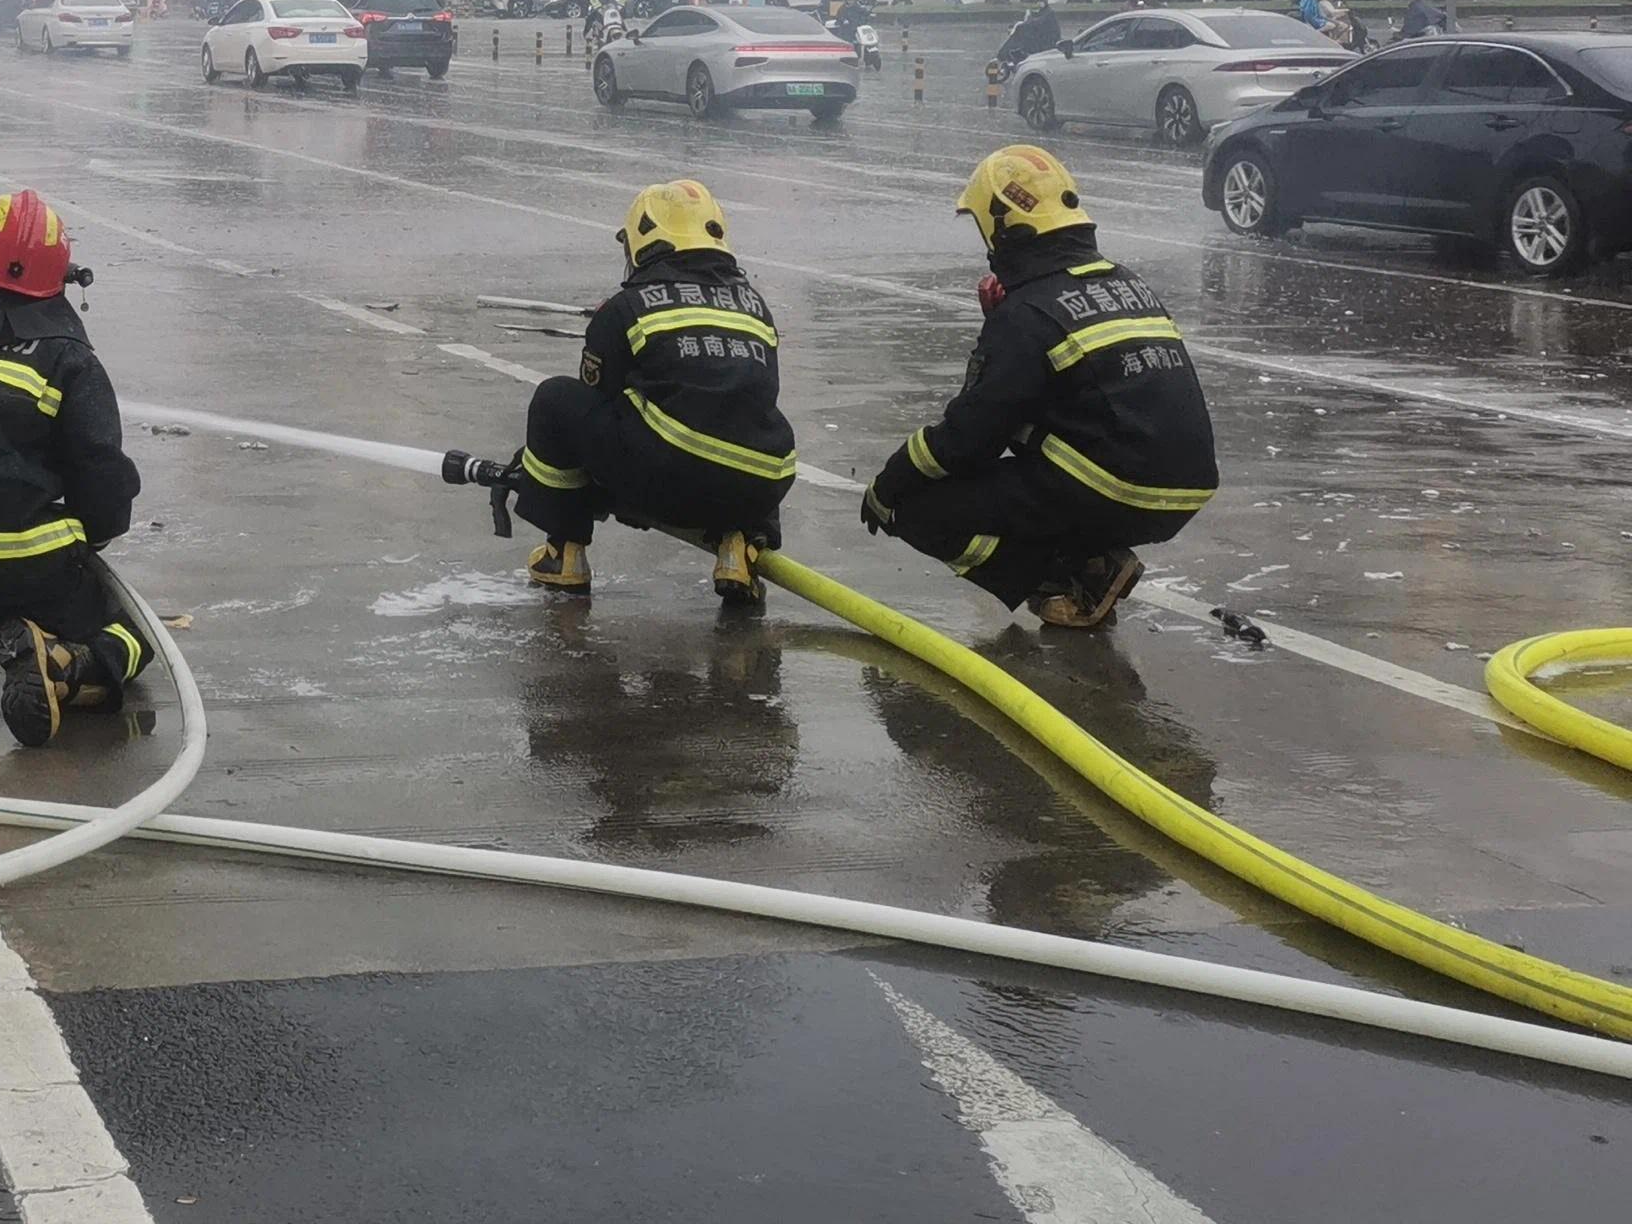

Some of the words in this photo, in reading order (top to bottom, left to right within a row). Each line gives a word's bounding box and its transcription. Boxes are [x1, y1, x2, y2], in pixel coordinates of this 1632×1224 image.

[638, 282, 765, 318] 应急消防
[1055, 279, 1161, 321] 应急消防
[676, 334, 769, 368] 海南海口
[1120, 345, 1184, 377] 海南海口
